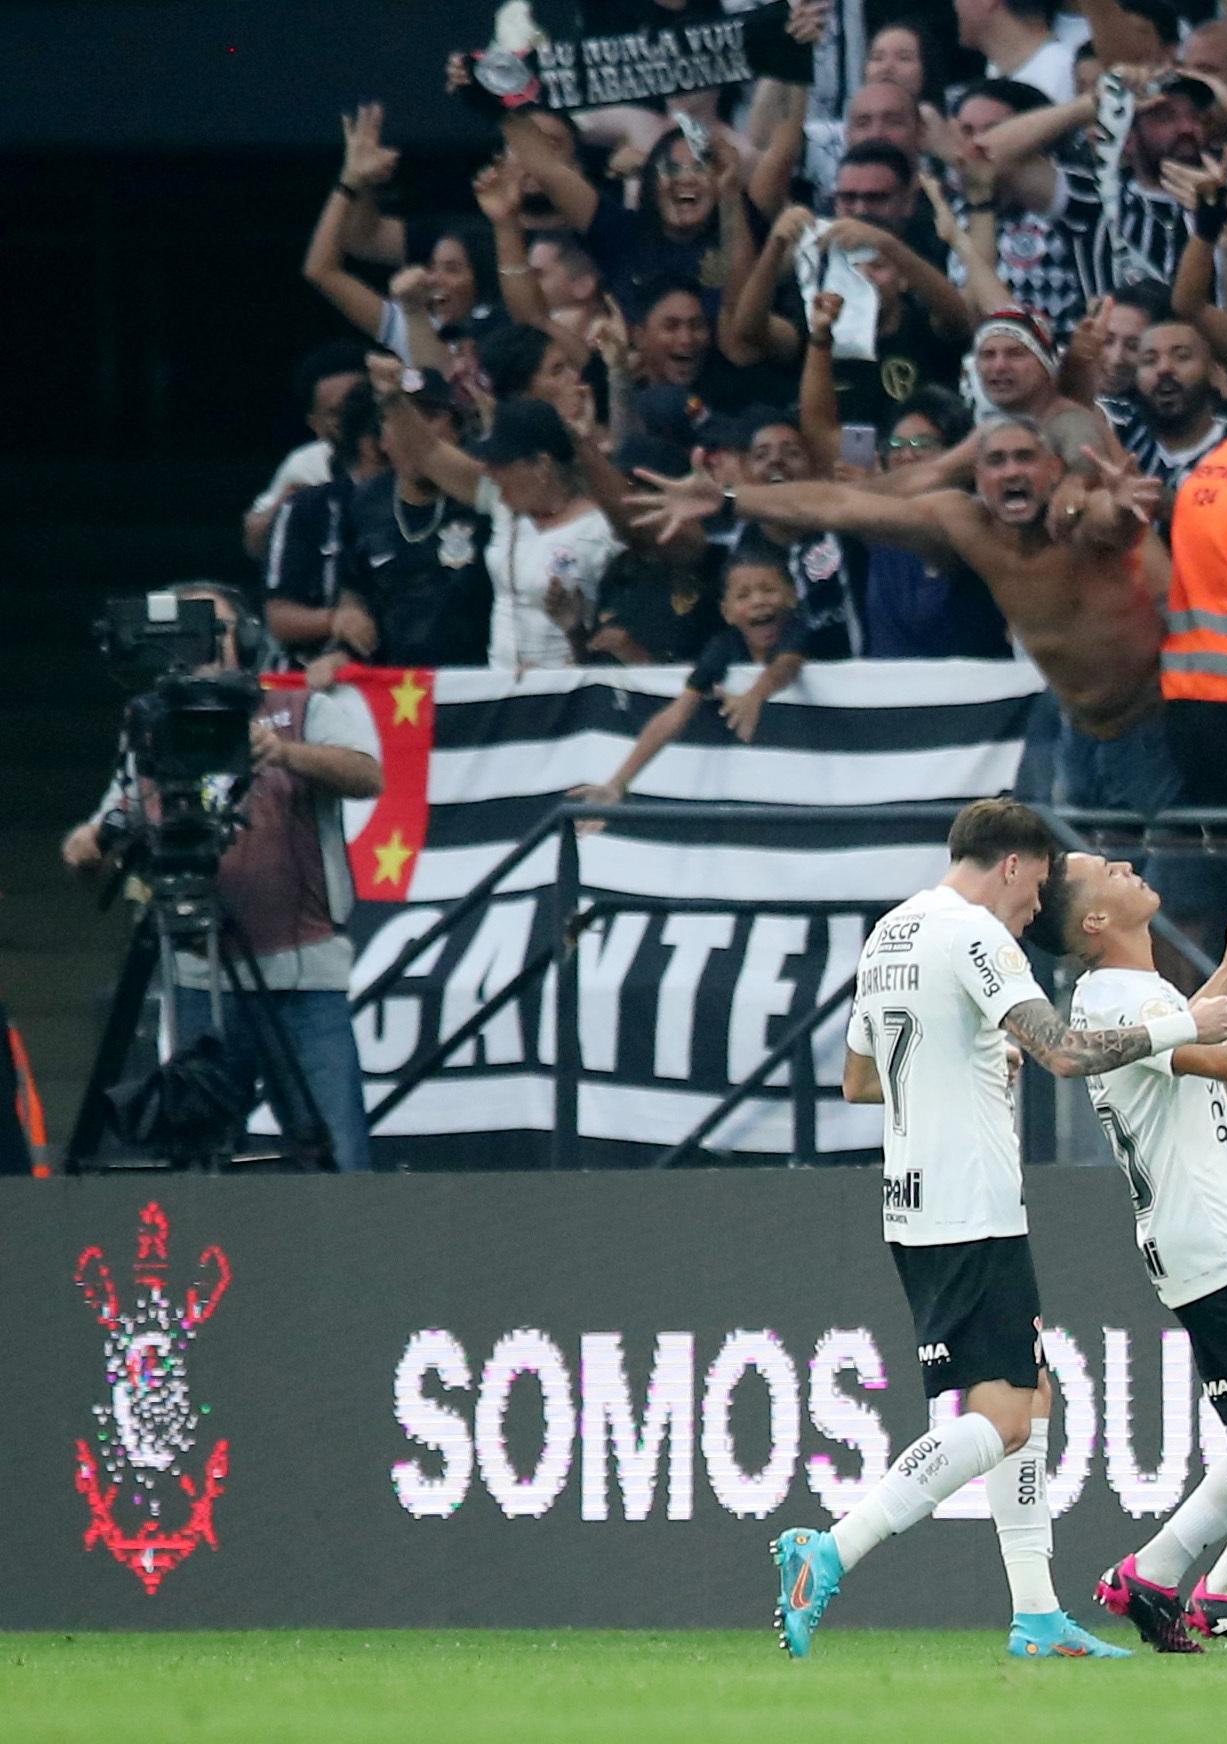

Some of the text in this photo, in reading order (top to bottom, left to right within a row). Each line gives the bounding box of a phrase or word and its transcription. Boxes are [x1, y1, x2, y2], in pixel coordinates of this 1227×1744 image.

[581, 32, 680, 67] NUNCA
[684, 20, 746, 53] VOU
[540, 50, 751, 109] TE ABANDONAR
[861, 963, 919, 998] BARLETTA
[970, 951, 1001, 998] bmg
[391, 1327, 891, 1520] SOMOS
[898, 1436, 942, 1477] TODOS
[1018, 1459, 1037, 1506] TODOS
